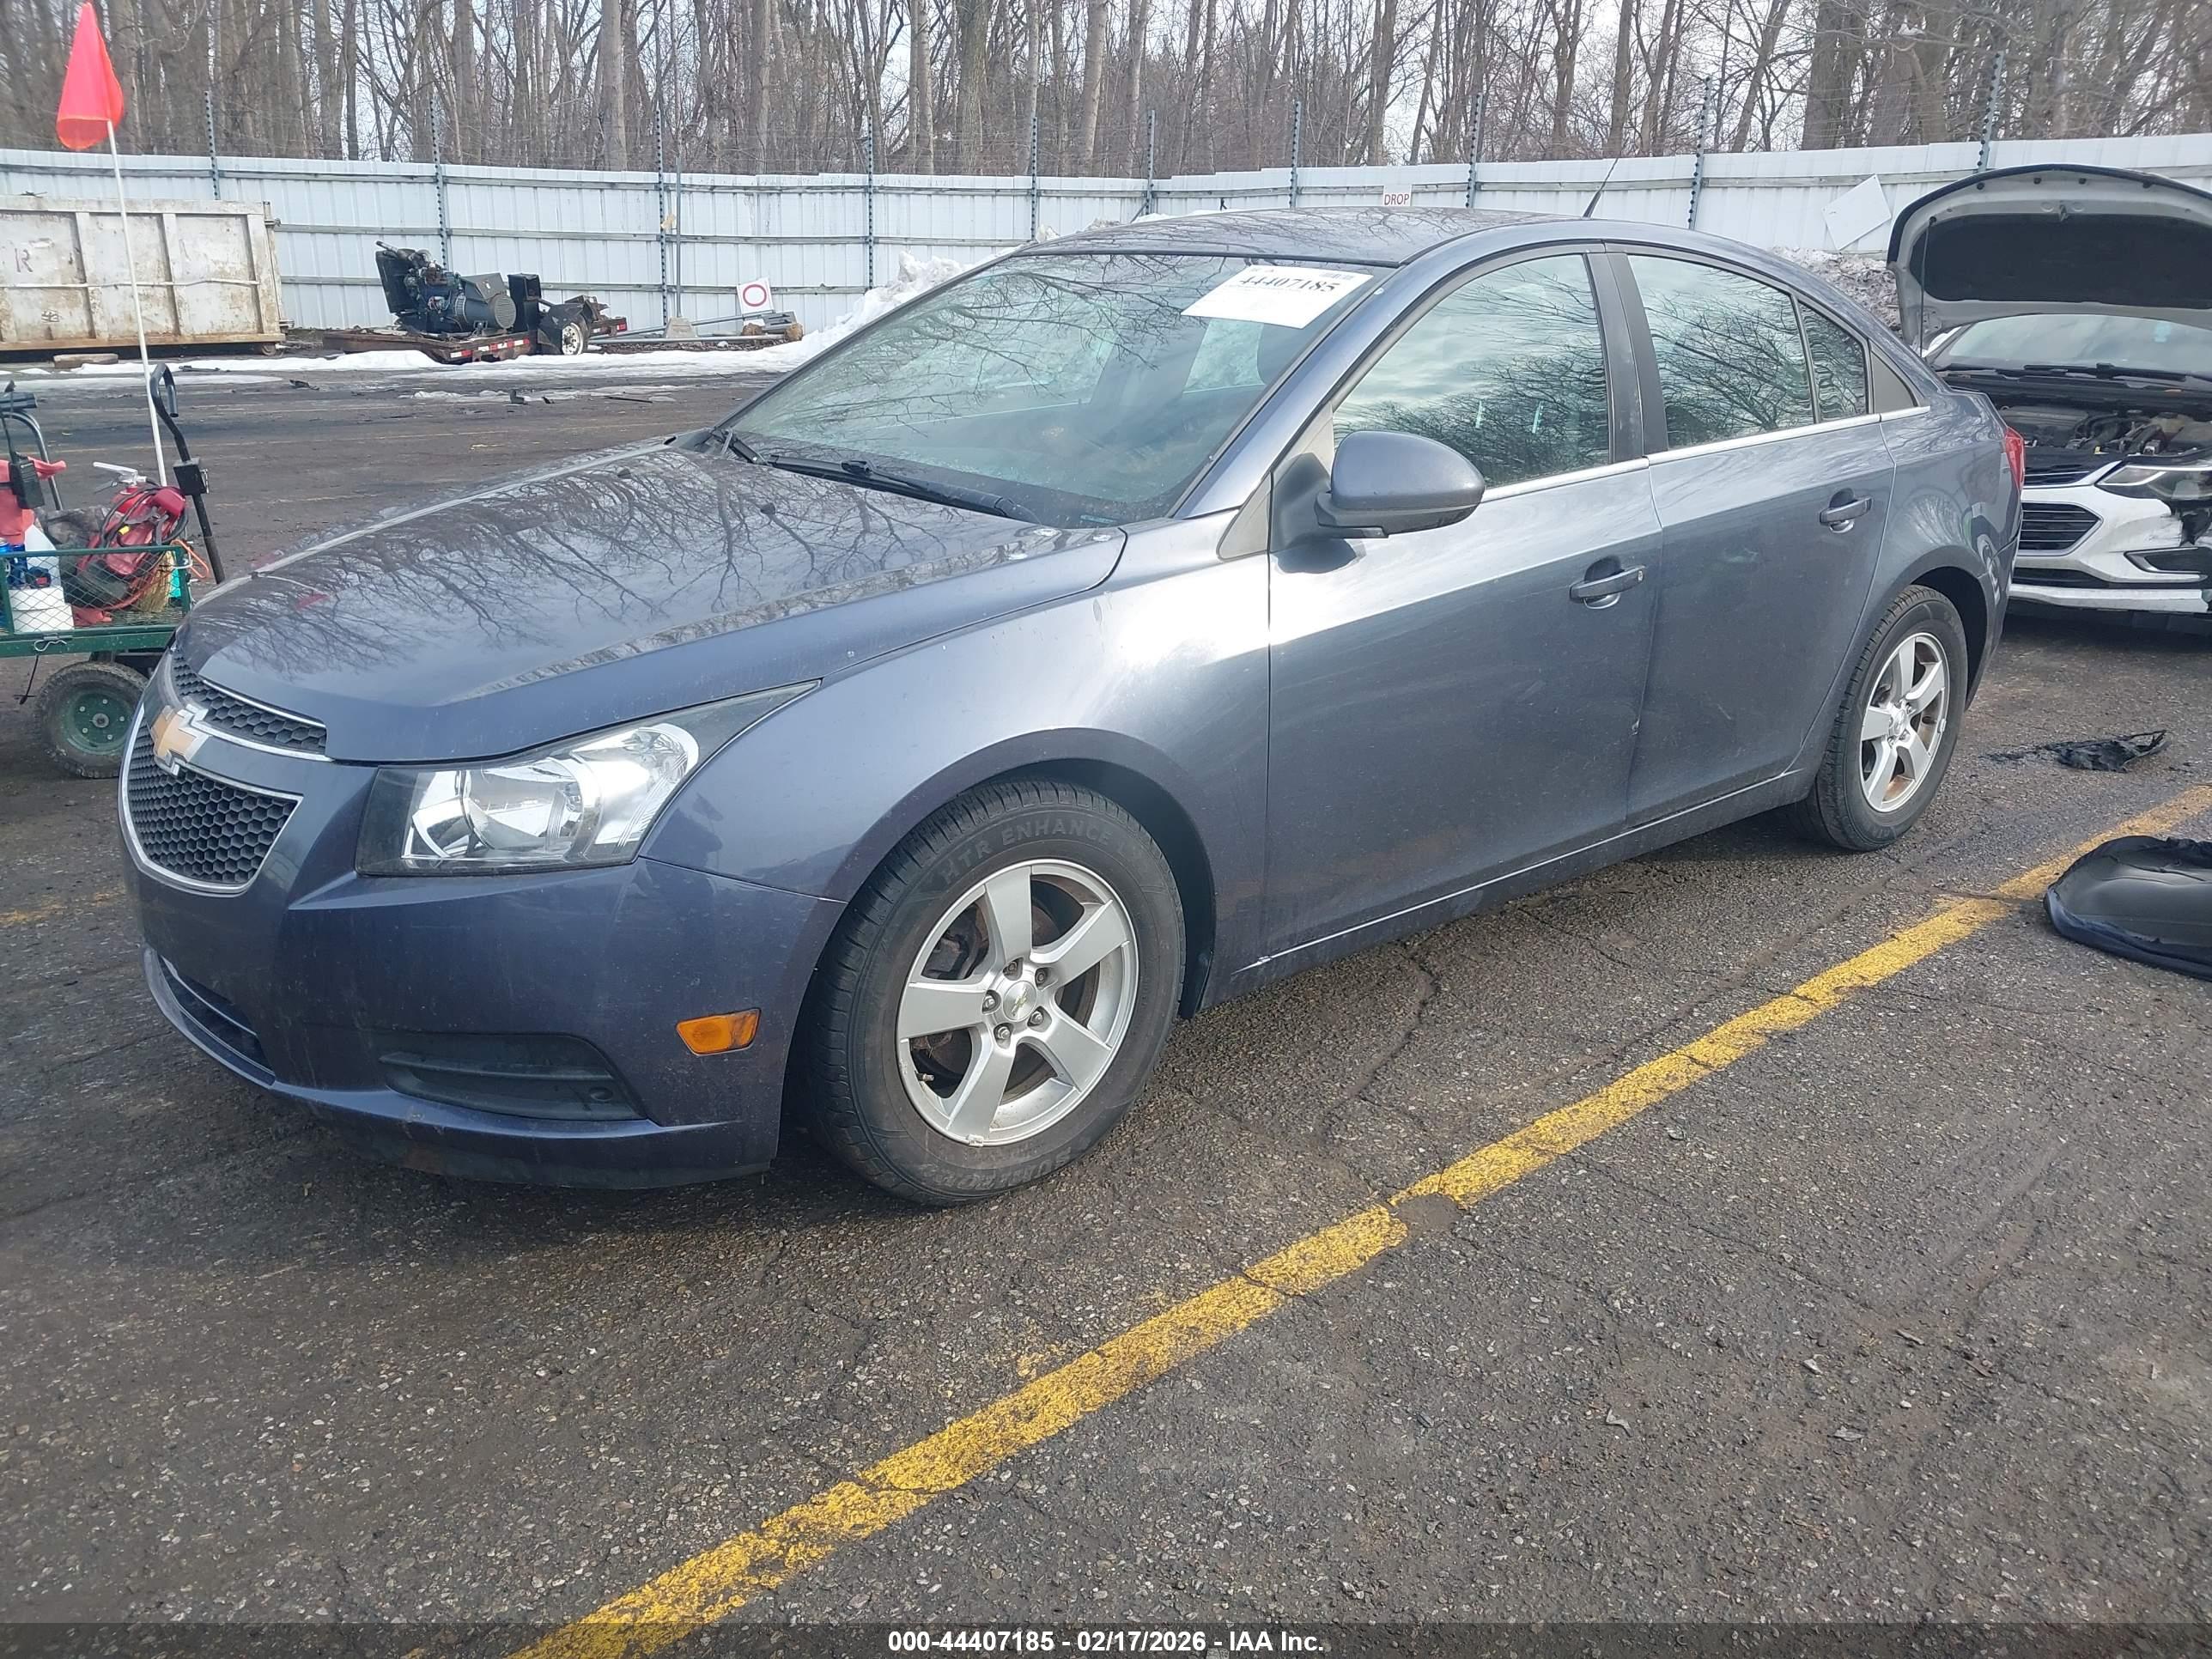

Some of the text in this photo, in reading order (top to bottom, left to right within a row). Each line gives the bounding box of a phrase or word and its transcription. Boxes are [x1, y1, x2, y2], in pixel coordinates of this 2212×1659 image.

[1384, 194, 1409, 205] DROP
[1239, 276, 1340, 292] 44407185
[1001, 817, 1113, 846] ENHANCE
